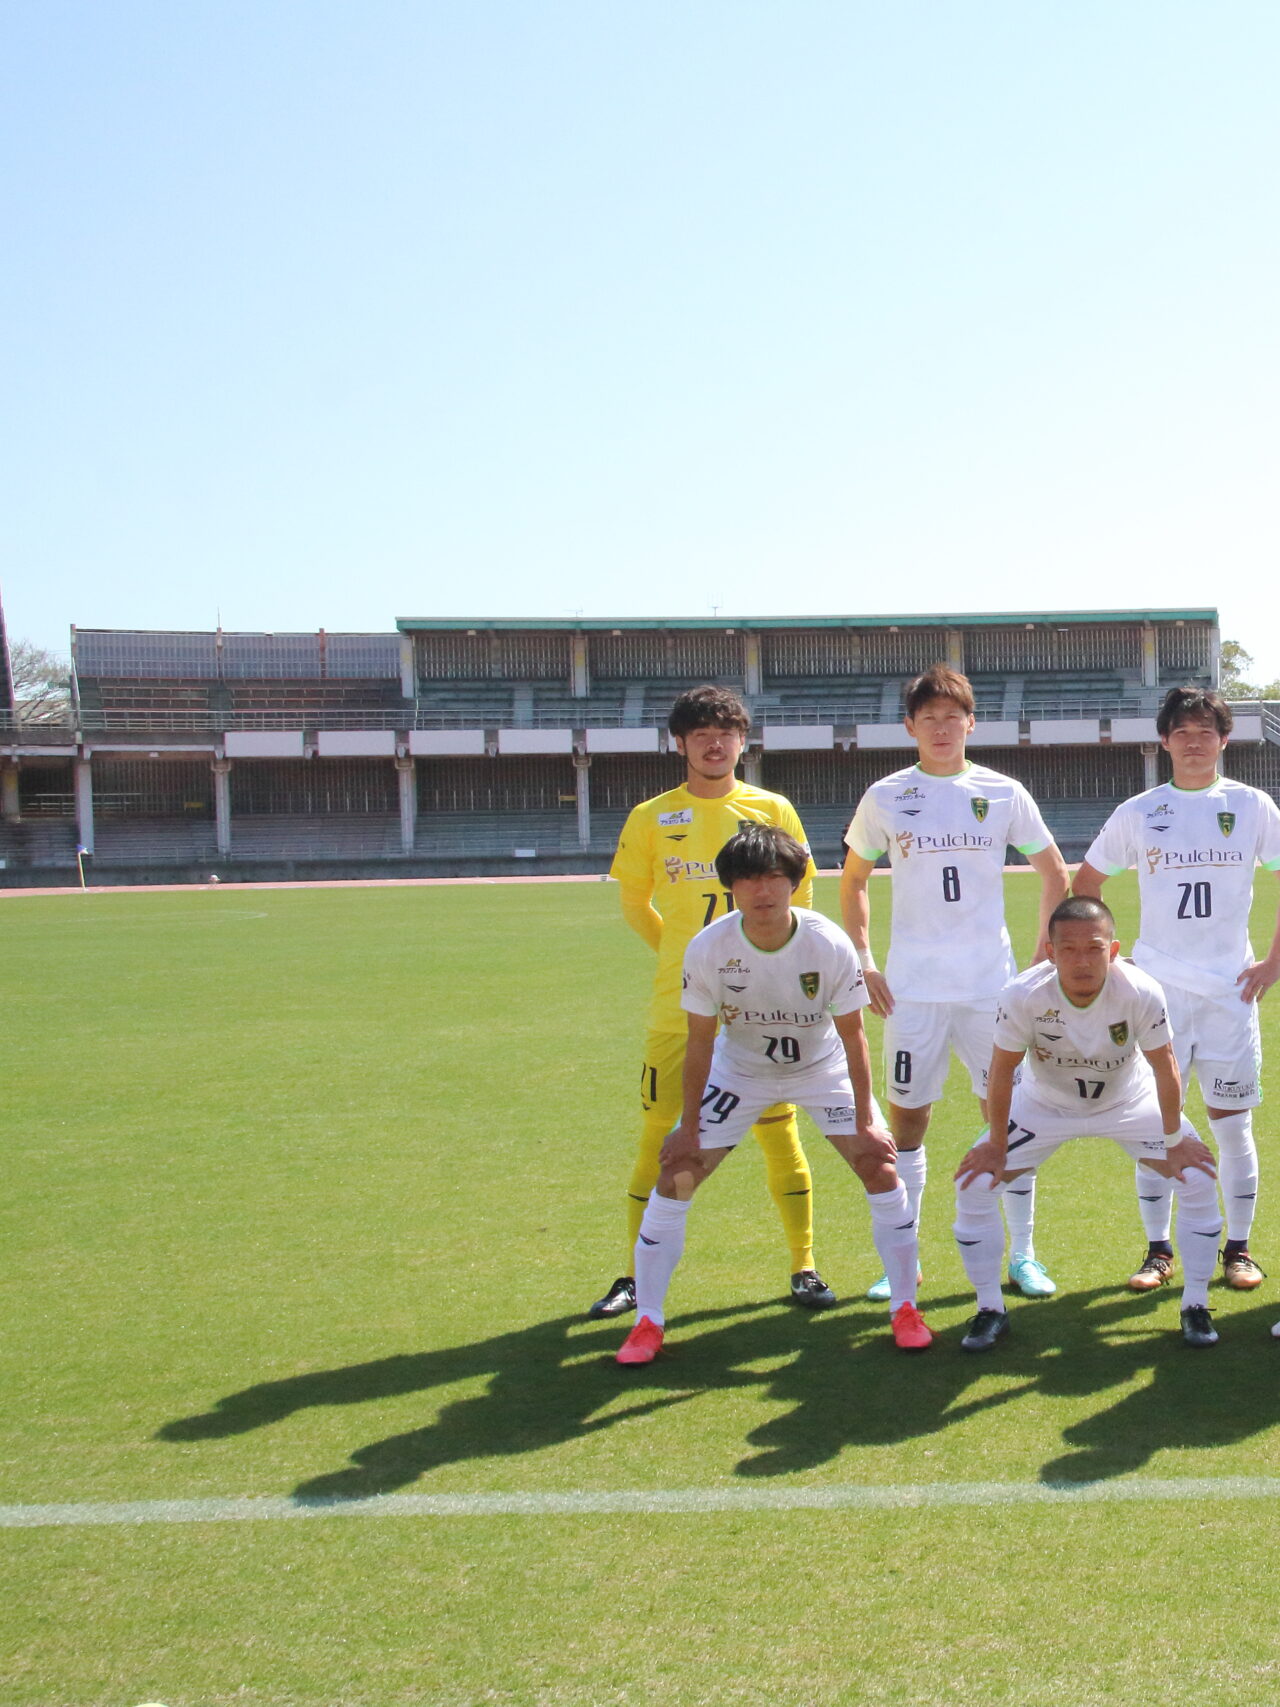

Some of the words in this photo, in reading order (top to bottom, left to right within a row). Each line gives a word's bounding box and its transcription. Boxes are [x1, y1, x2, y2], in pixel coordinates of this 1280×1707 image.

[917, 832, 993, 849] Pulchra
[1165, 848, 1243, 865] Pulchra
[942, 865, 961, 902] 8
[702, 892, 735, 927] 21
[1177, 881, 1211, 919] 20
[745, 1009, 822, 1023] Pulchr
[762, 1034, 801, 1064] 29
[895, 1050, 912, 1084] 8
[1074, 1077, 1106, 1099] 17
